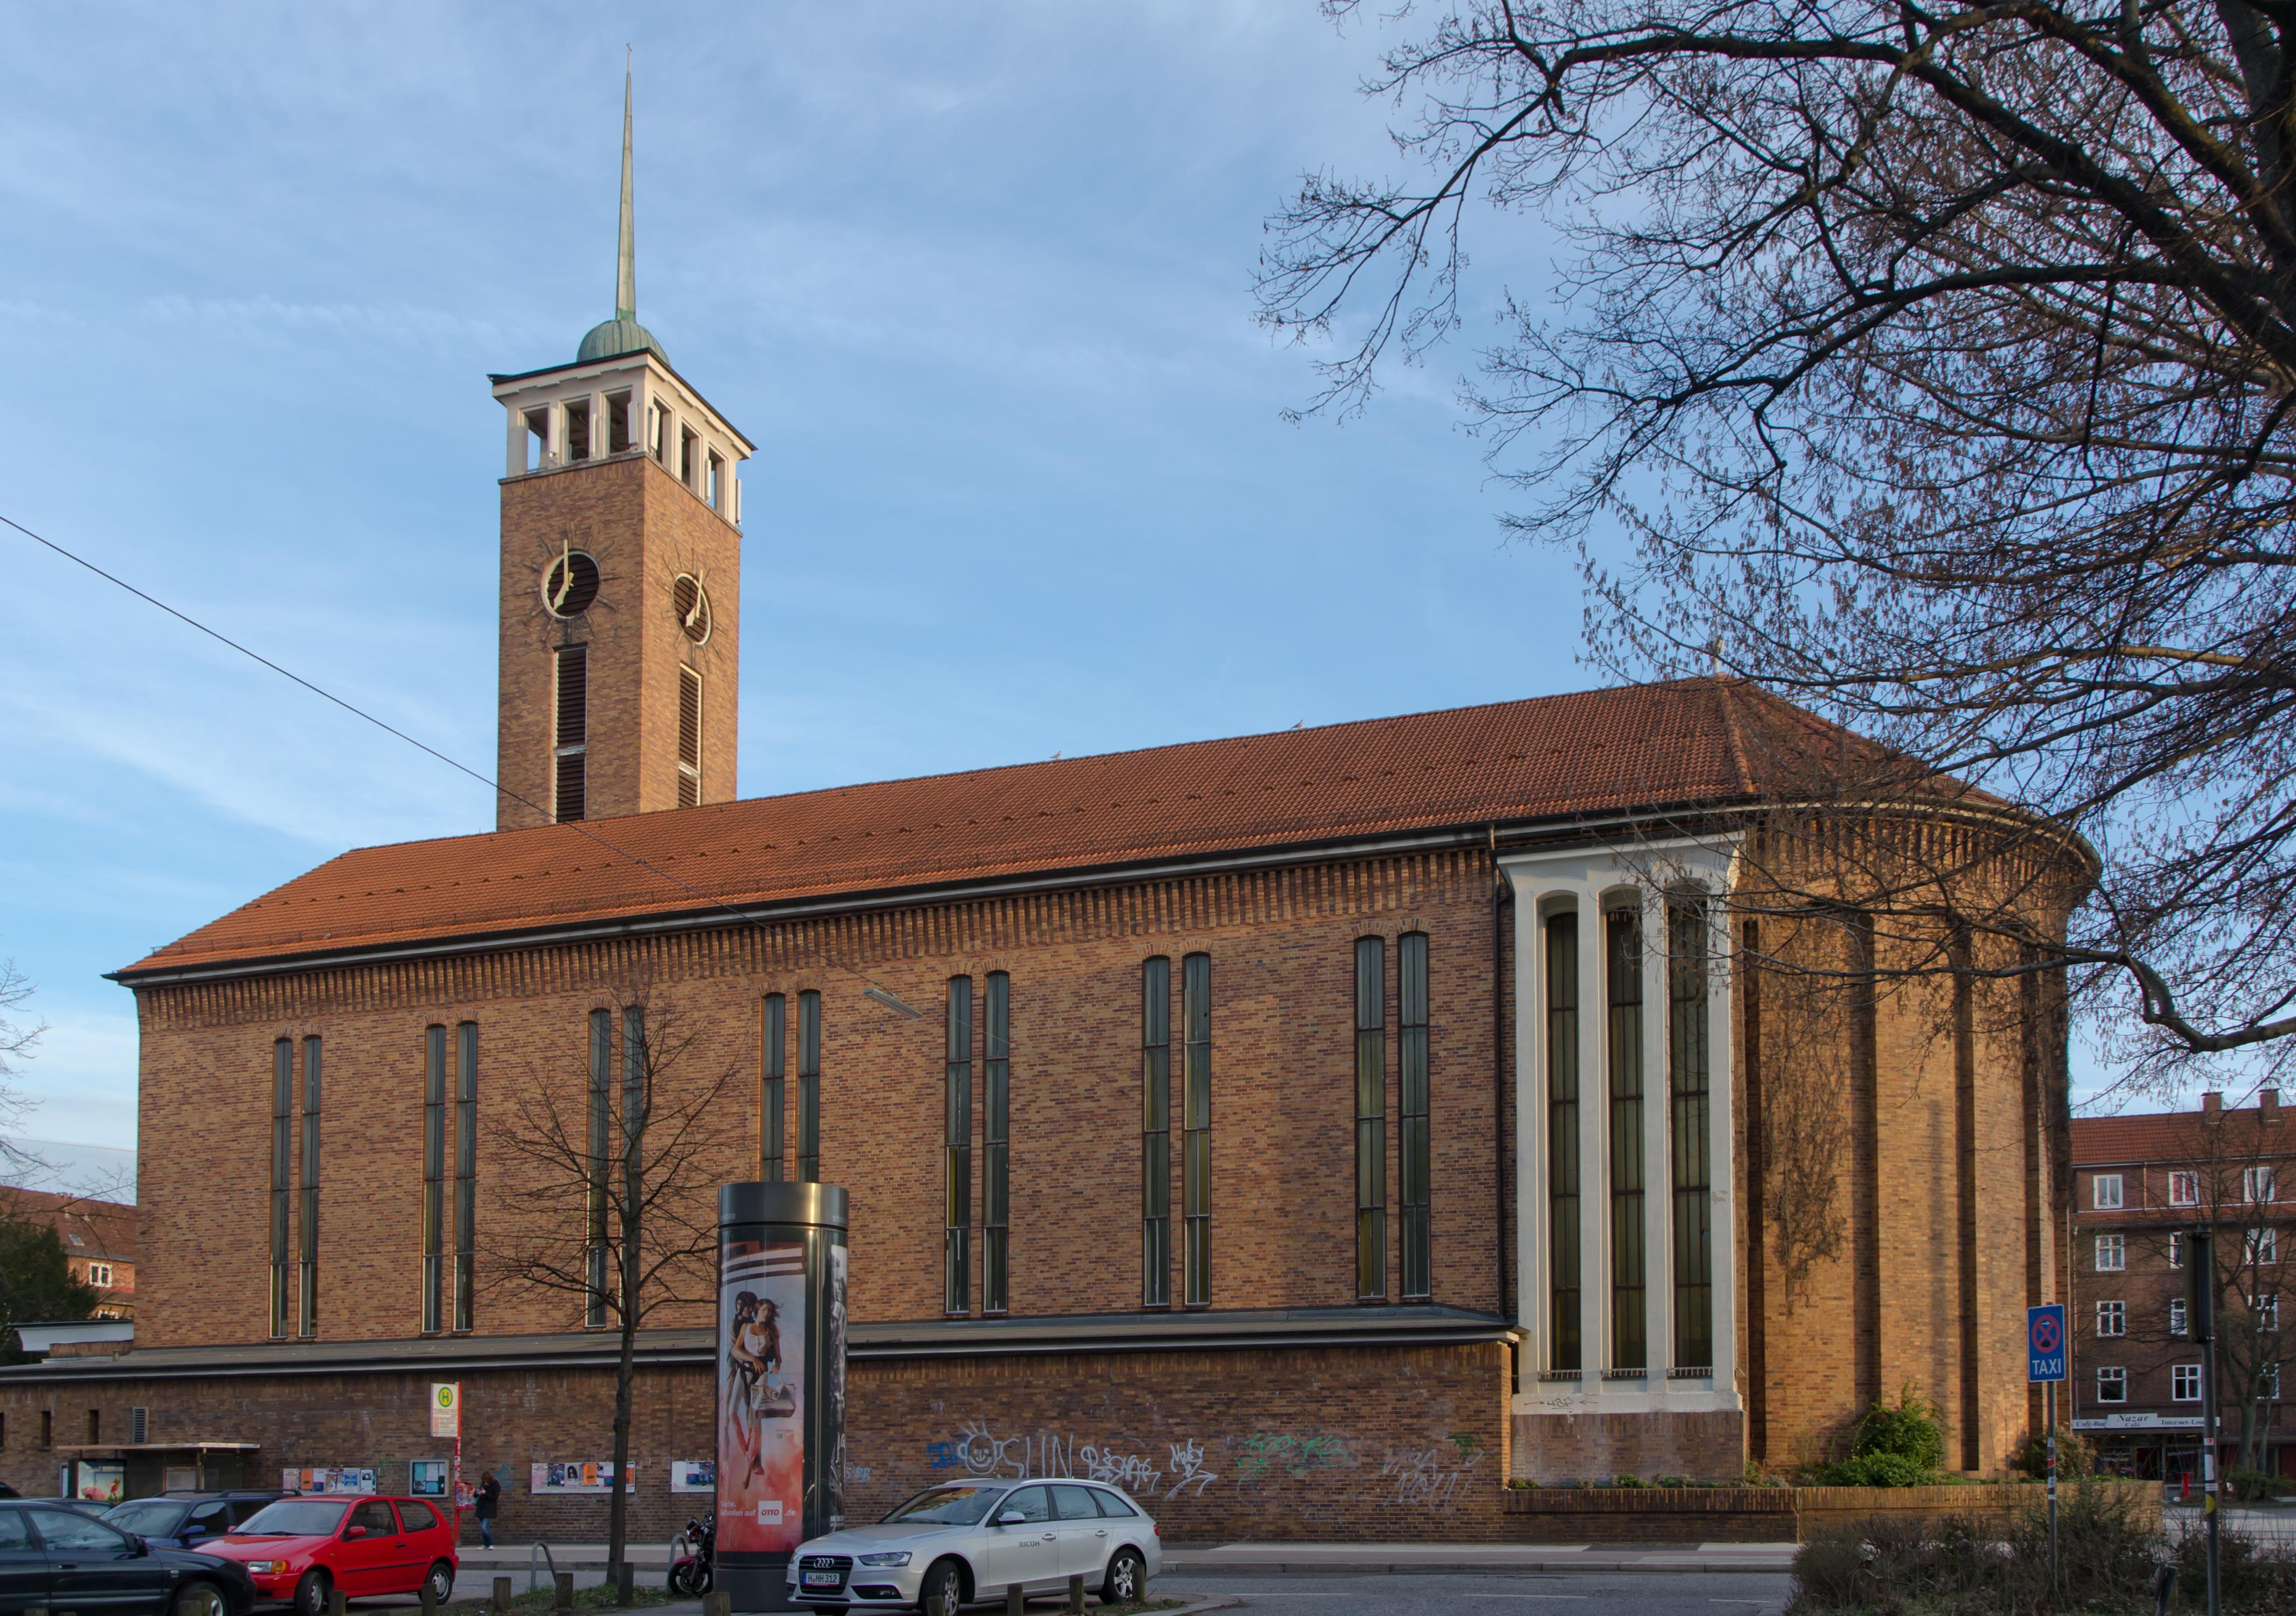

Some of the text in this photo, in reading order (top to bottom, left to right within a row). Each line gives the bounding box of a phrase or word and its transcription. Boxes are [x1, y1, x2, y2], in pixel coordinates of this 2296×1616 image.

[2032, 1358, 2061, 1375] TAXI
[442, 1391, 449, 1402] H
[825, 1575, 837, 1583] 312
